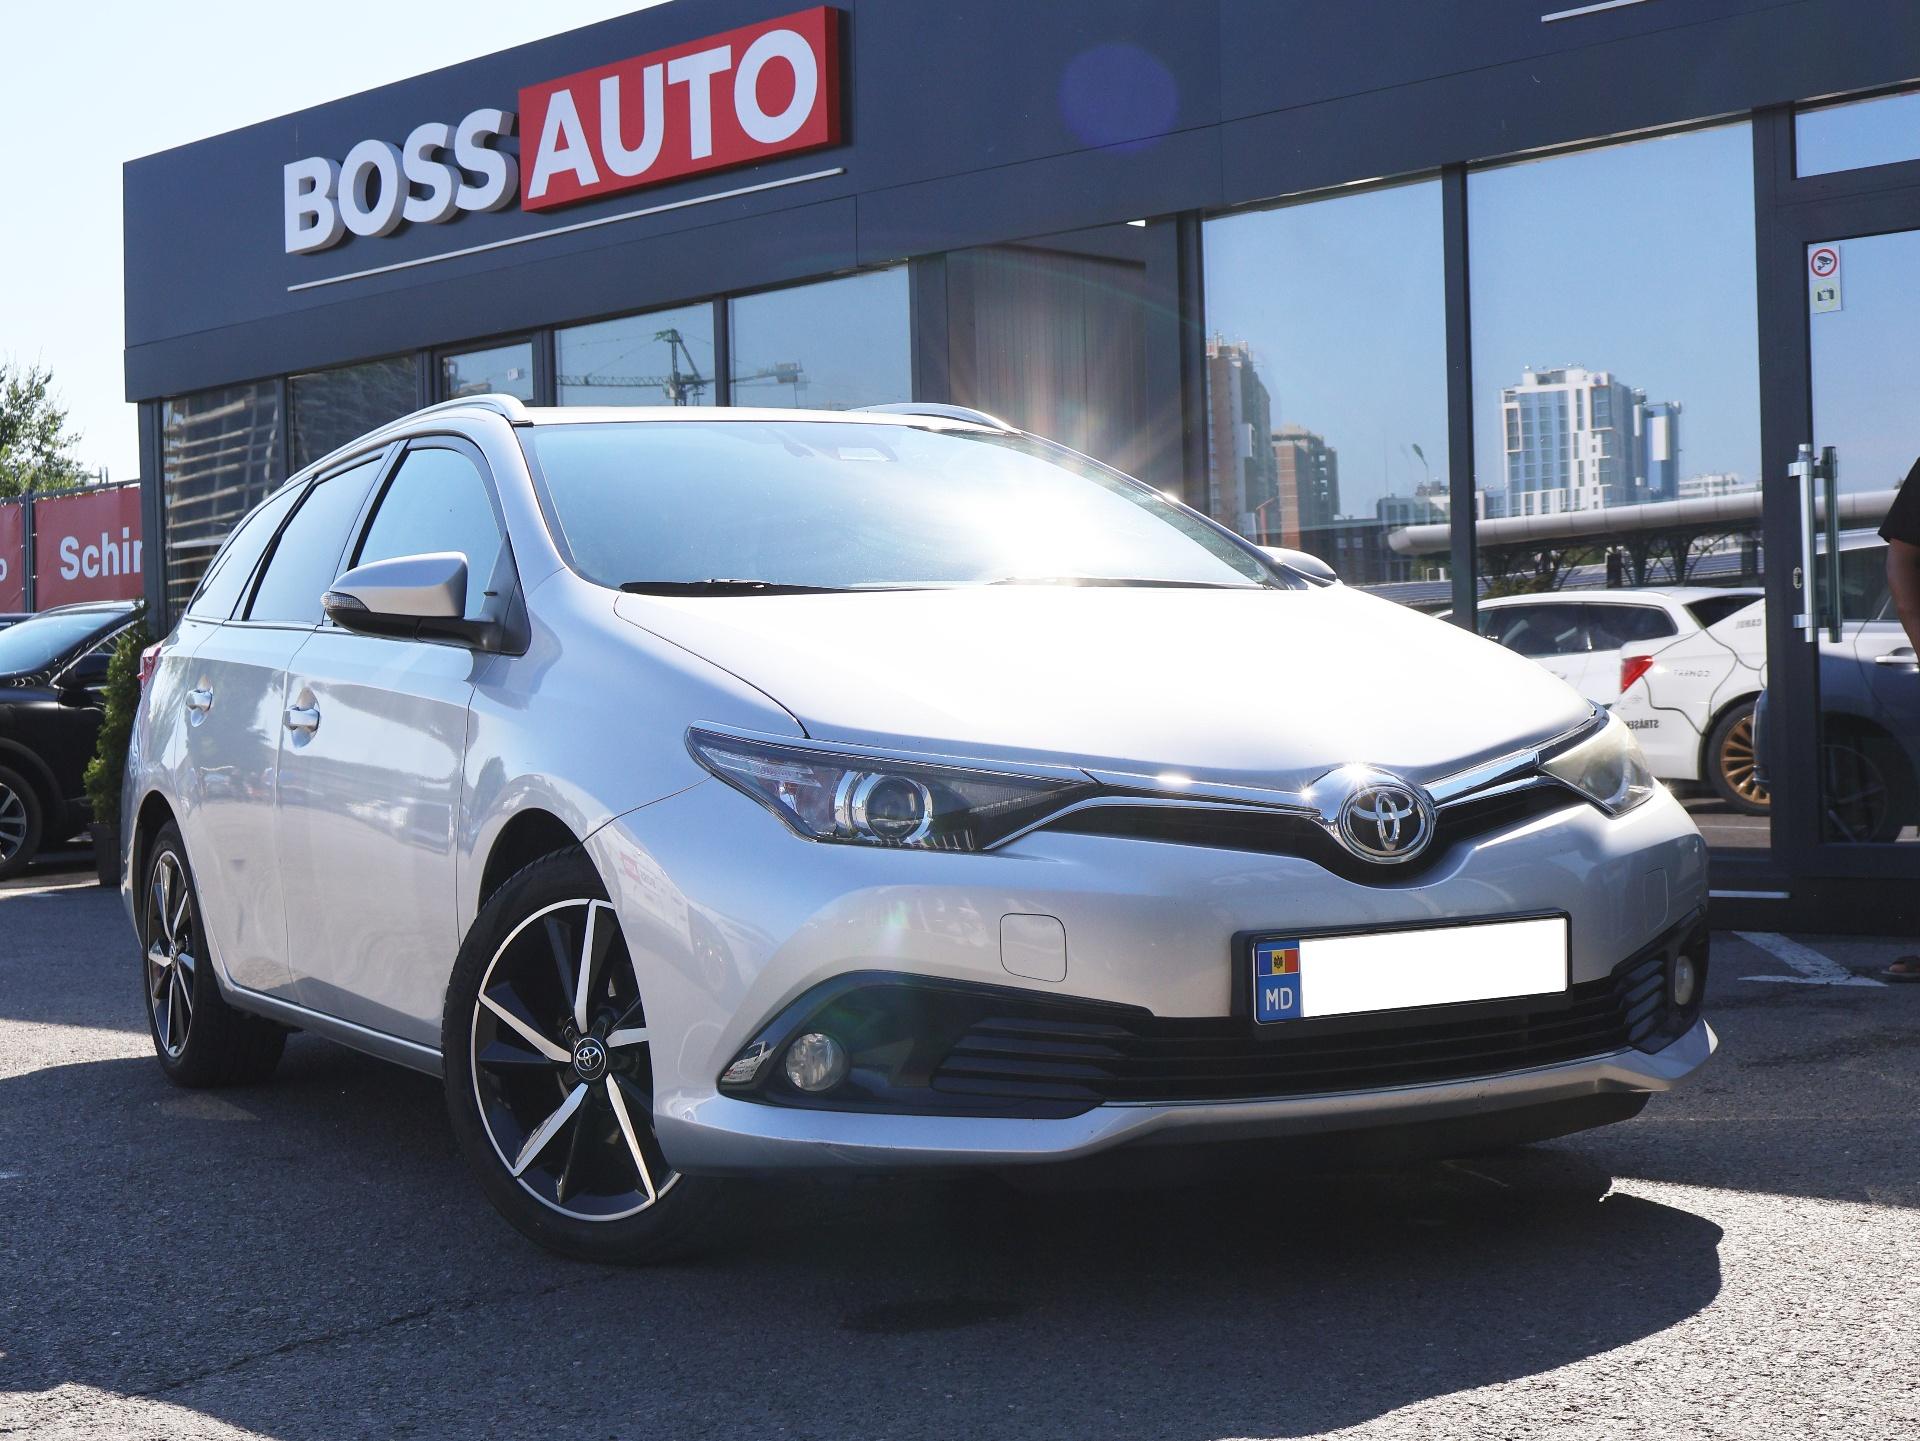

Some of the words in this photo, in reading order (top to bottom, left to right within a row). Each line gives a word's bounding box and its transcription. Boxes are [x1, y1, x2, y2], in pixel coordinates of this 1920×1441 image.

[284, 108, 516, 253] BOSS
[528, 29, 818, 199] AUTO
[1265, 987, 1293, 1011] MD
